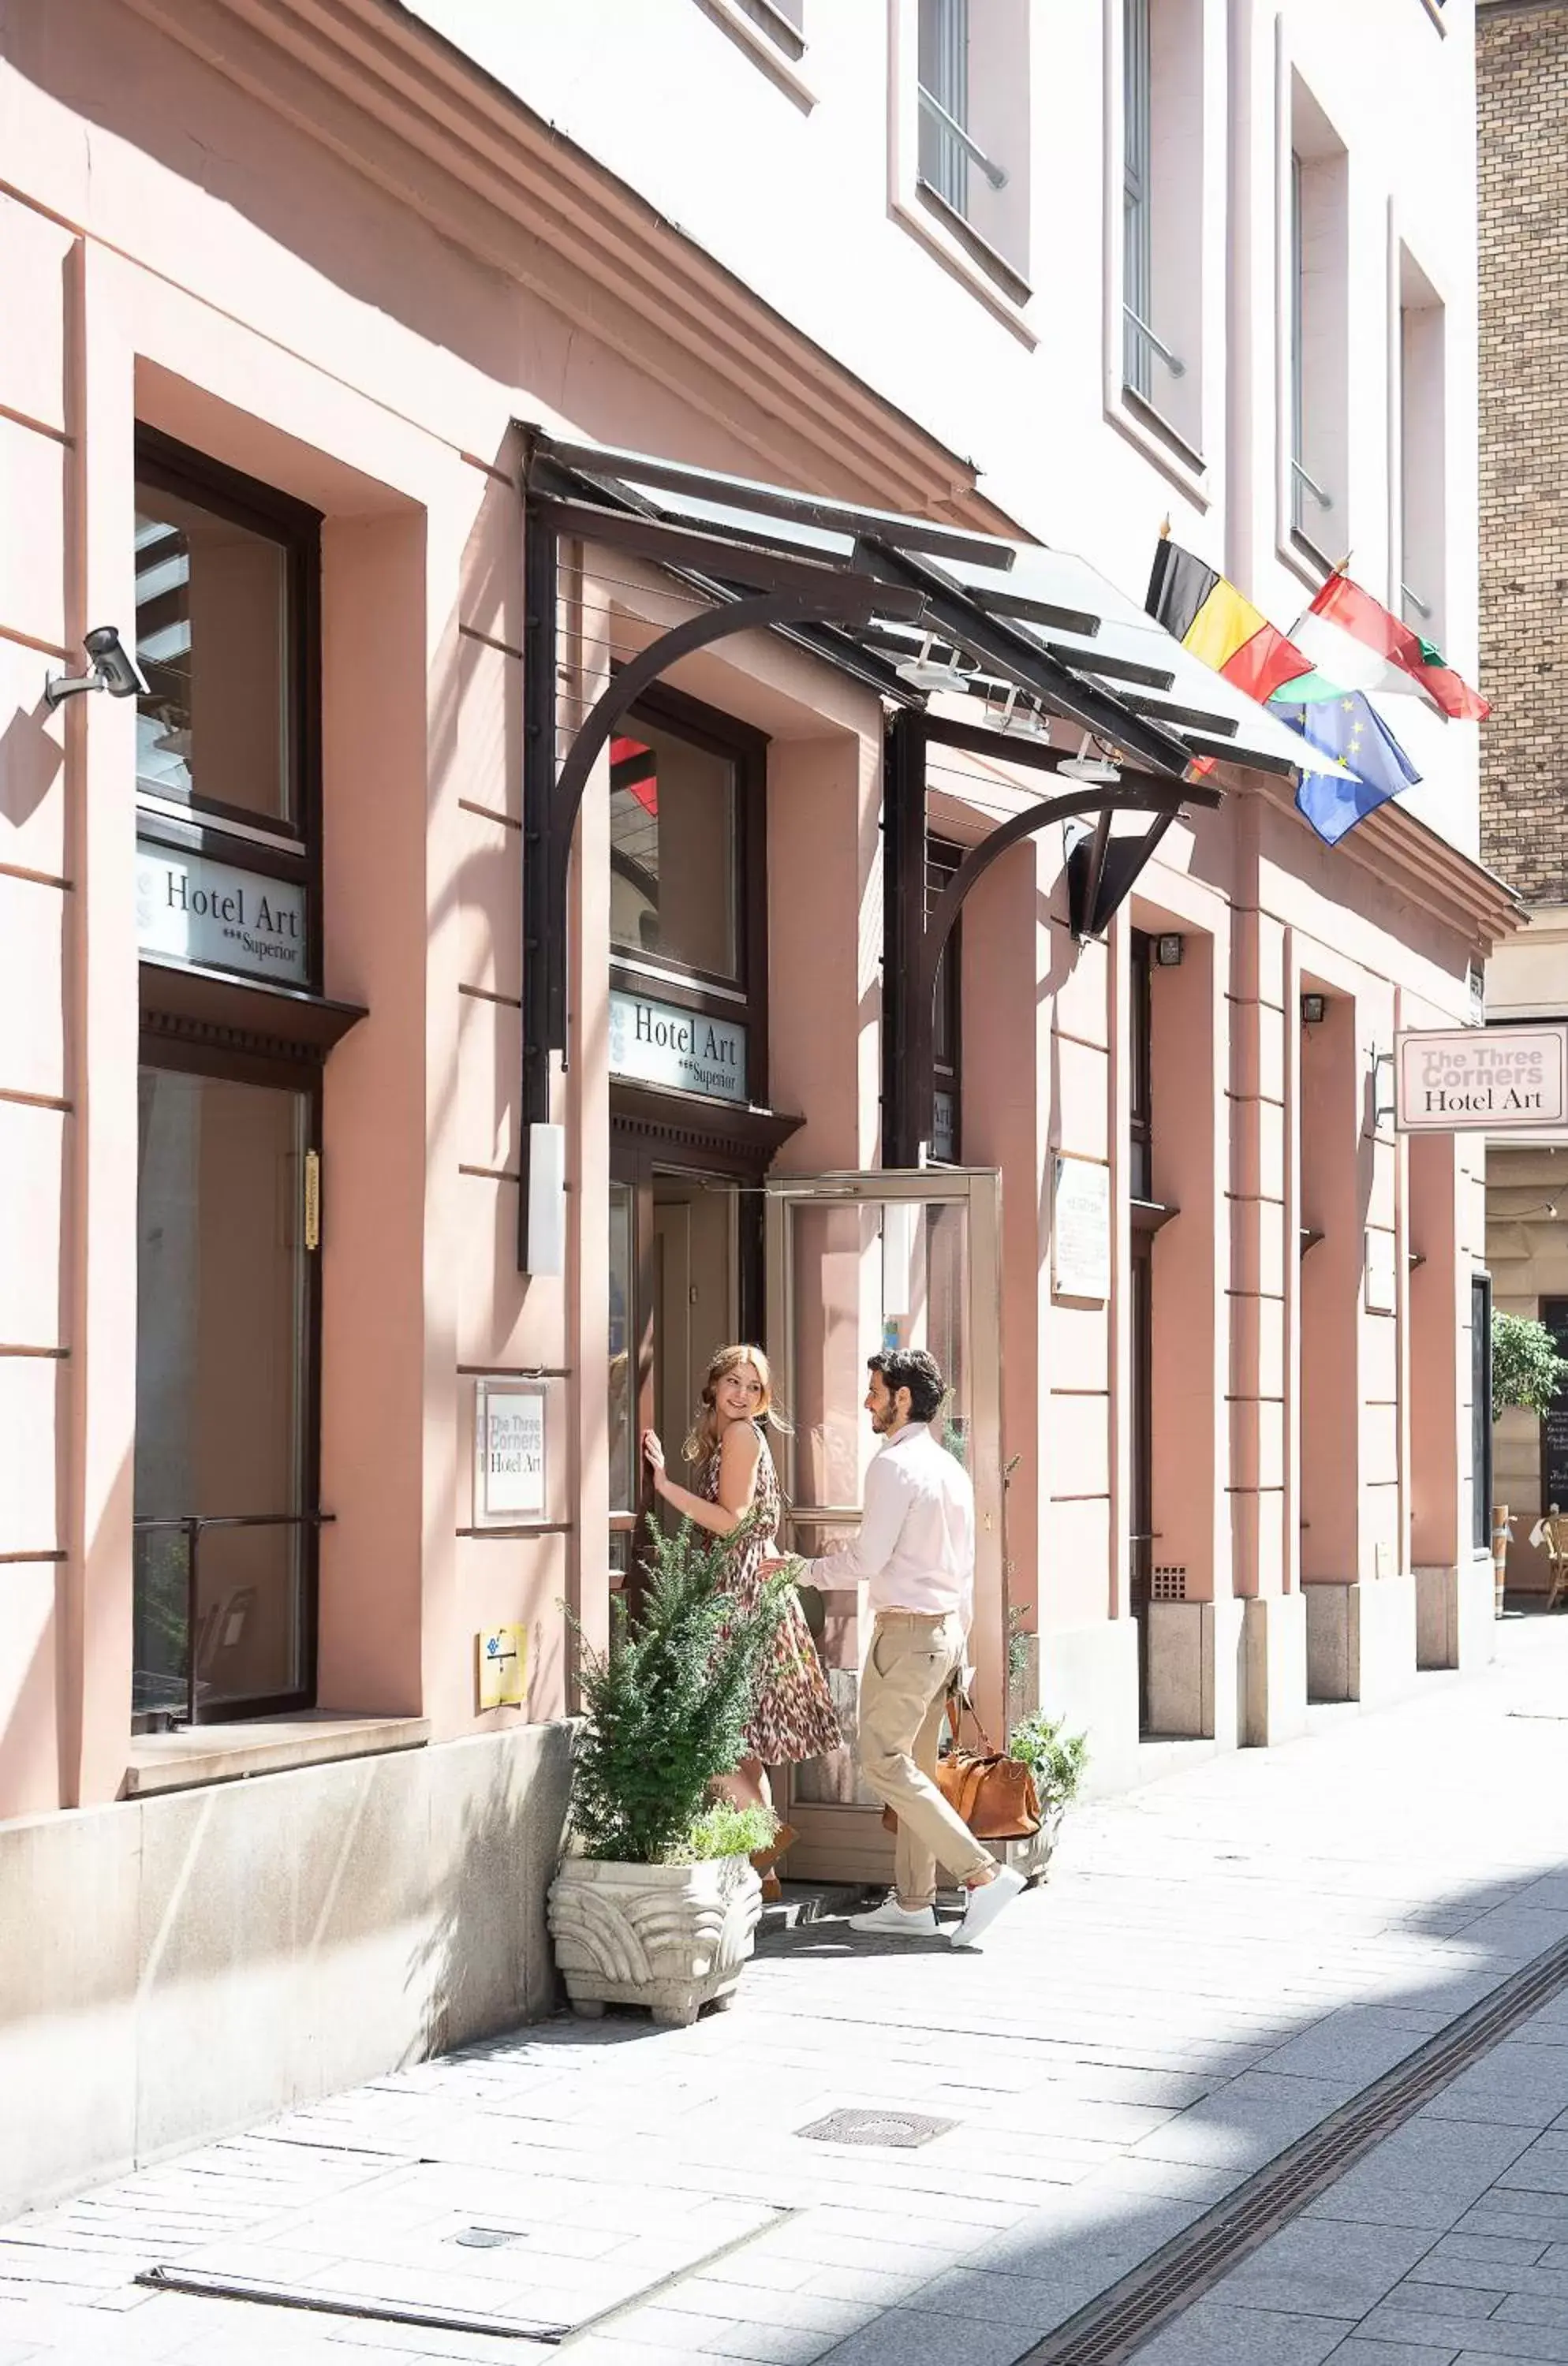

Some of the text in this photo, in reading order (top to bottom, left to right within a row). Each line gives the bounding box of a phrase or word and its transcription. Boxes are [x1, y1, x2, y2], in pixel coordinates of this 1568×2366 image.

[166, 871, 245, 924] Hotel
[256, 895, 299, 938] Art
[242, 932, 298, 962] Superior
[635, 1004, 696, 1054] Hotel
[704, 1024, 737, 1065] Art
[1422, 1049, 1543, 1068] The Three
[694, 1062, 735, 1090] Superior
[1422, 1066, 1543, 1087] Corners
[1425, 1088, 1541, 1111] Hotel Art
[490, 1415, 540, 1431] The Three
[490, 1432, 541, 1450] Corners
[491, 1453, 540, 1472] Hotel Art
